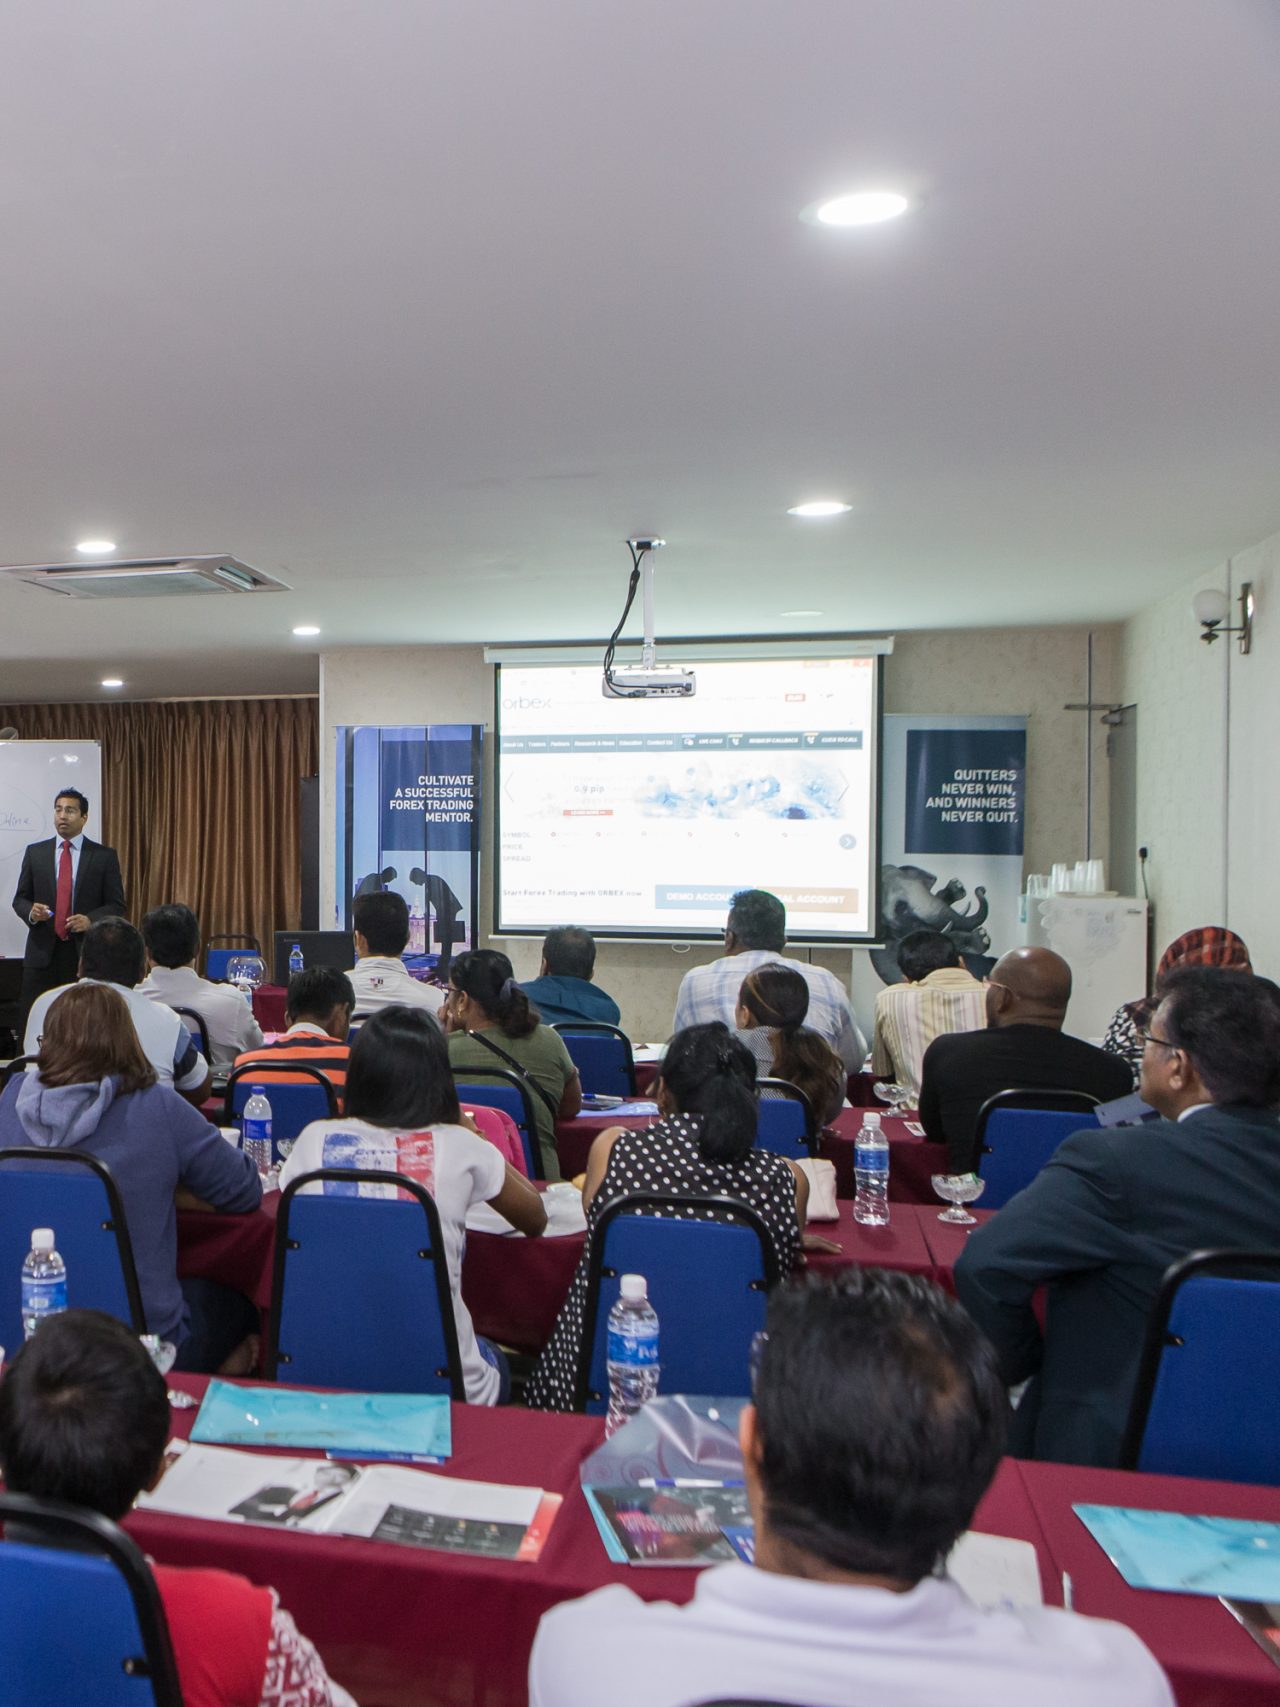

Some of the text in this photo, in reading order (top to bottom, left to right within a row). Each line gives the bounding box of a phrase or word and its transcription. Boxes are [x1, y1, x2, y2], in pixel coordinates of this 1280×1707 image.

[502, 696, 552, 710] orbex
[418, 775, 474, 786] CULTIVATE
[953, 769, 1018, 781] QUITTERS
[394, 787, 474, 798] A SUCCESSFUL
[941, 783, 1017, 796] NEVER WIN,
[389, 800, 474, 811] FOREX TRADING
[925, 797, 1017, 809] AND WINNERS
[425, 812, 474, 823] MENTOR.
[941, 811, 1019, 823] NEVER QUIT.
[666, 892, 732, 902] DEMO ACCOU
[797, 895, 845, 904] ACCOUNT
